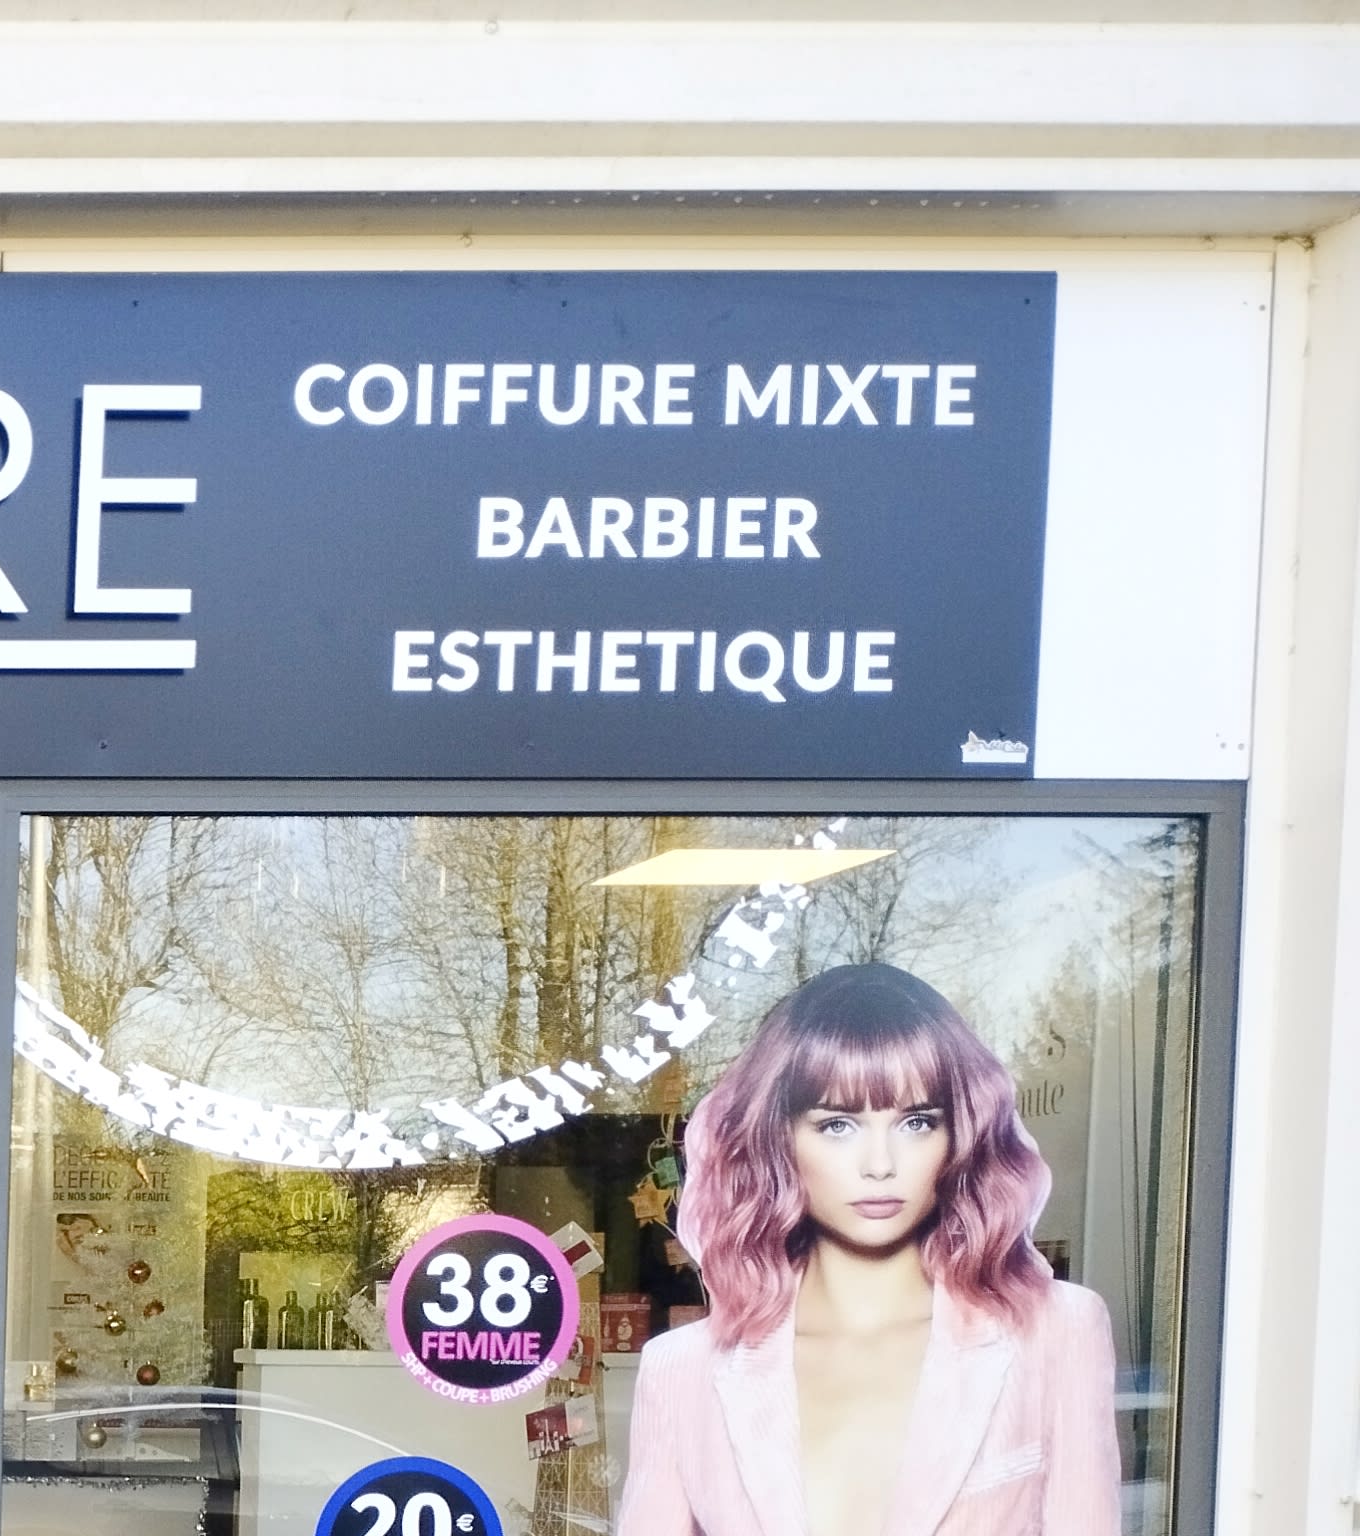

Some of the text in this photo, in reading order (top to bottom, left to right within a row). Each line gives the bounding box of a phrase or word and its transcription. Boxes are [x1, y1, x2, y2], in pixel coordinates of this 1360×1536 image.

[293, 363, 977, 426] COIFFURE MIXTE
[475, 496, 821, 558] BARBIER
[390, 630, 896, 703] ESTHETIQUE
[420, 1330, 542, 1361] FEMME
[400, 1351, 425, 1377] SHP
[431, 1379, 480, 1404] COUPE
[491, 1357, 558, 1403] BRUSHING
